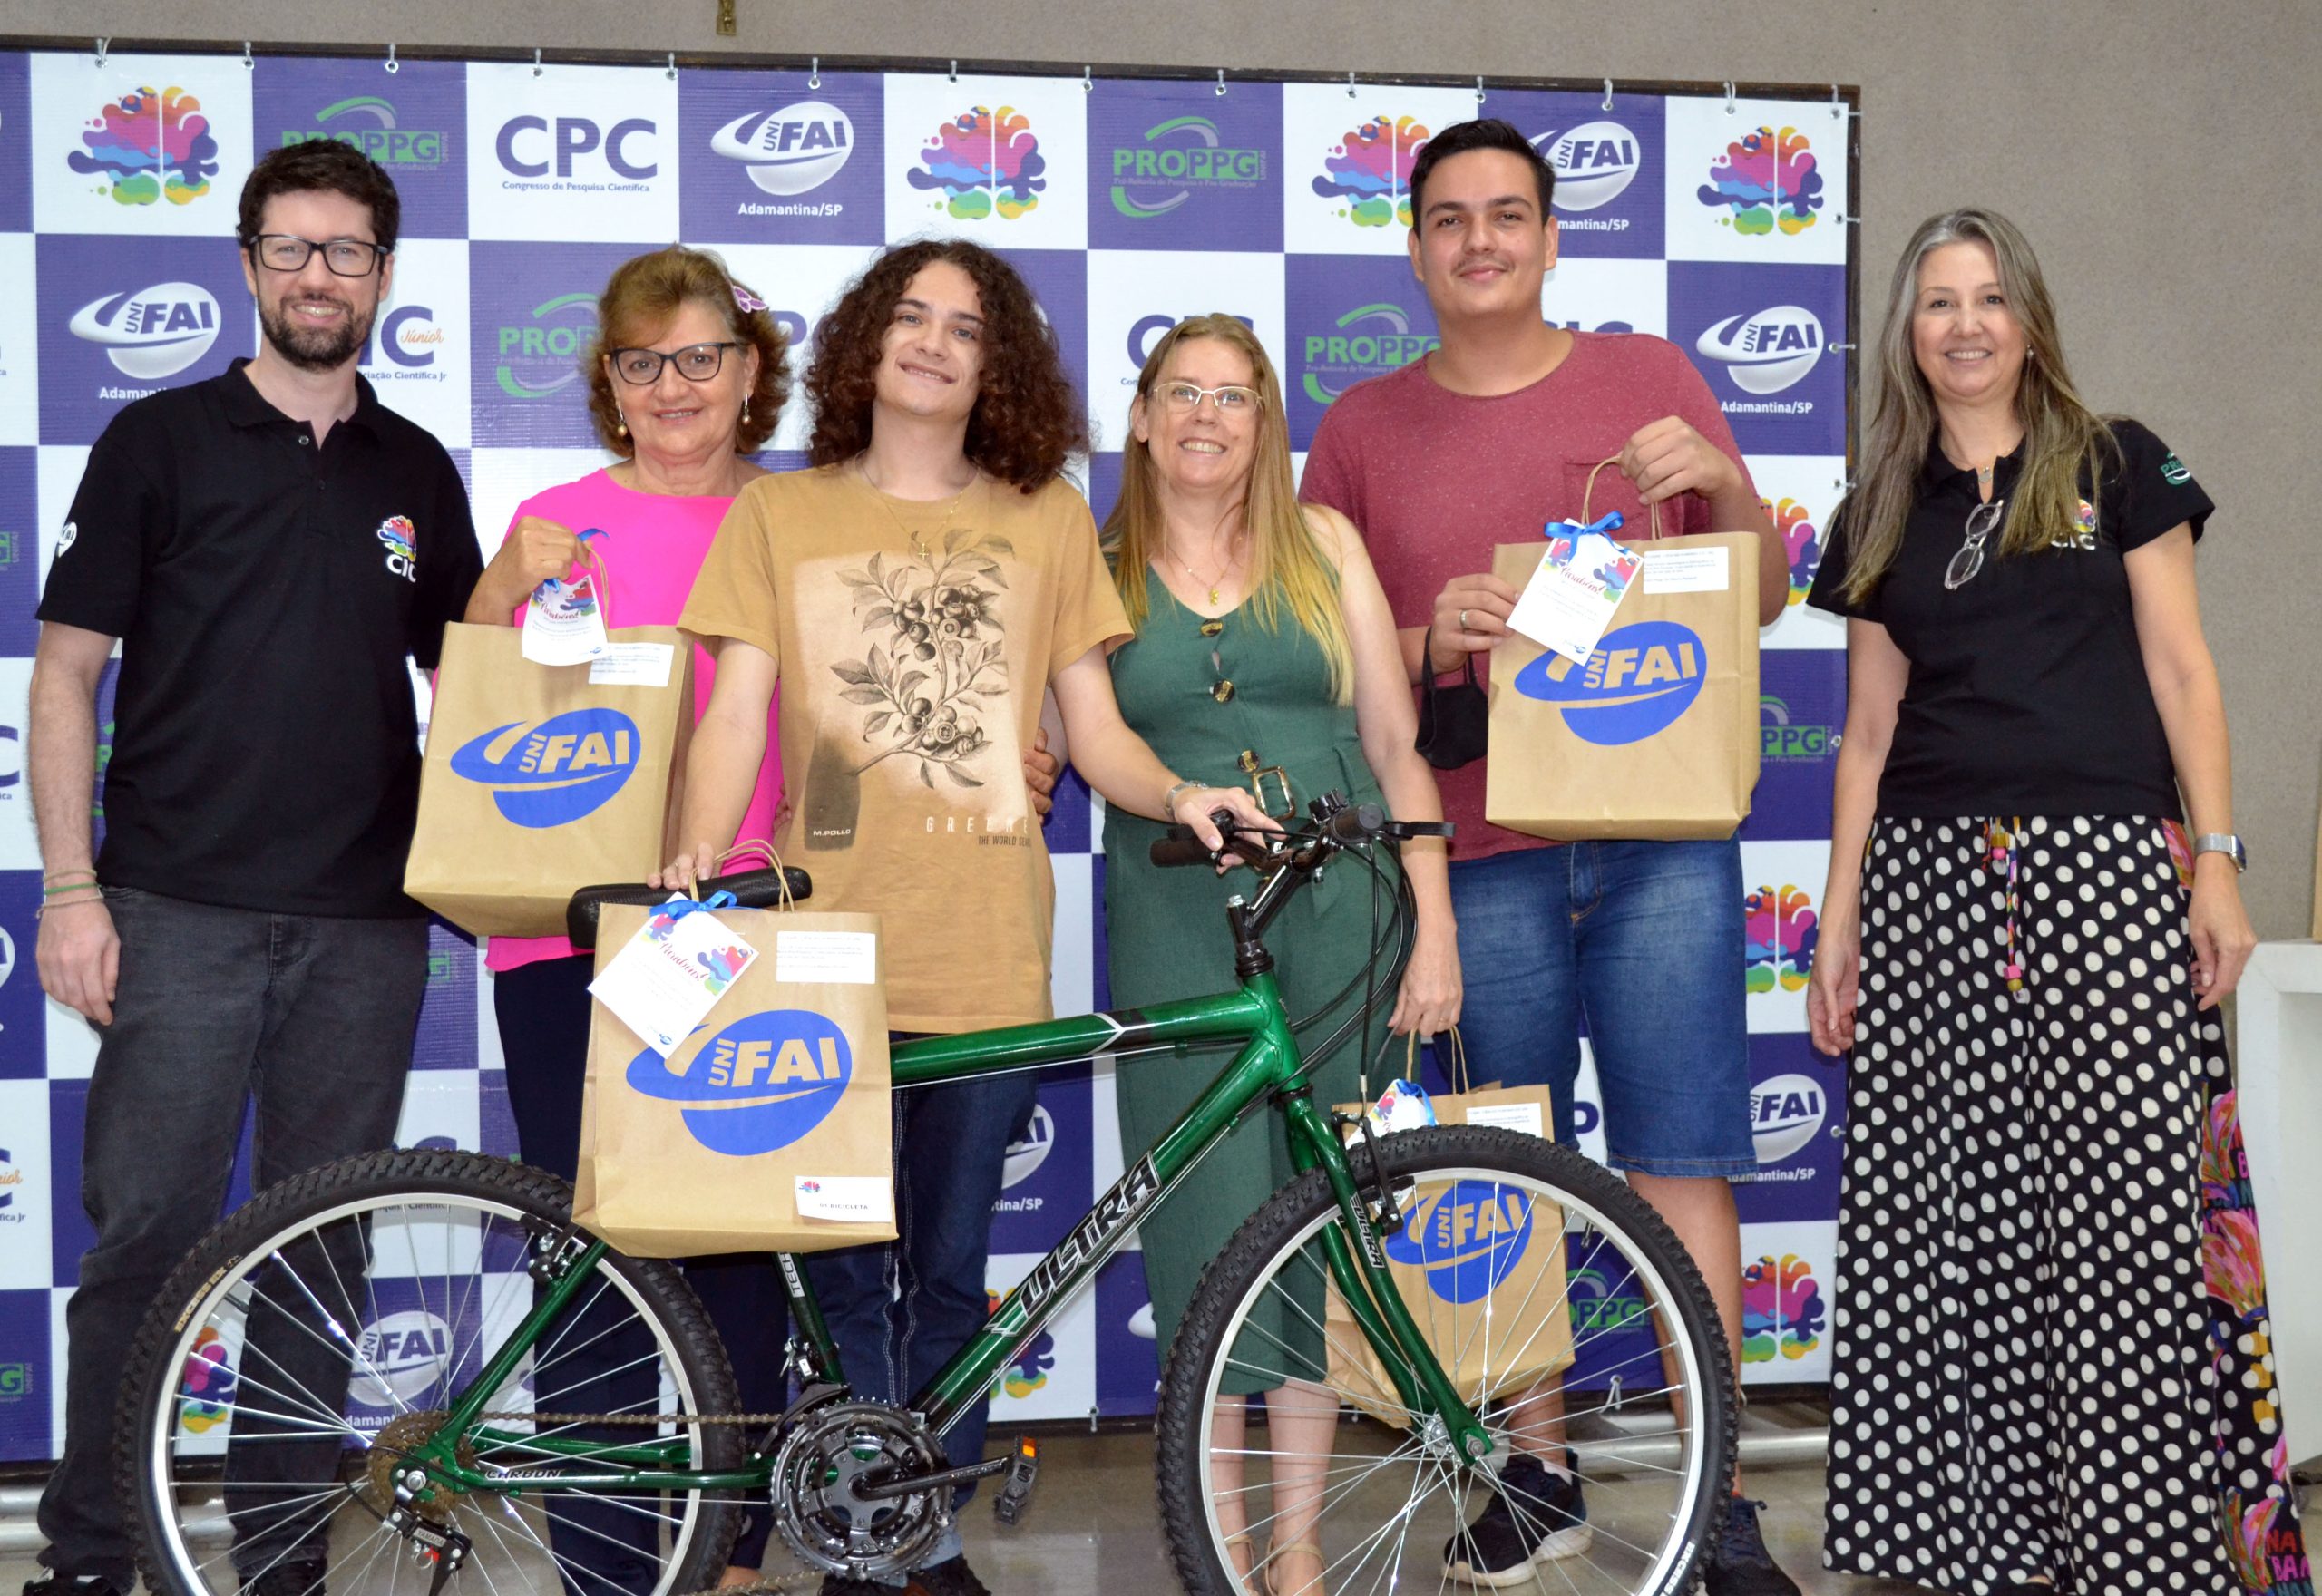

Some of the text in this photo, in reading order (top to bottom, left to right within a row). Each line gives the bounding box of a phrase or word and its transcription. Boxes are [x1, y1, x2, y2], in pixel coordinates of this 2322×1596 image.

[496, 115, 658, 180] CPC
[777, 121, 847, 152] FAI
[1113, 149, 1256, 178] PROPPG
[1570, 140, 1634, 170] FAI
[502, 180, 650, 192] Congresso de Pesquisa Científica
[737, 202, 843, 217] Adamantina/SP
[1557, 218, 1630, 231] mantina/SP
[140, 301, 214, 335] FAI
[1756, 323, 1818, 354] FAI
[395, 371, 437, 380] Científica
[440, 372, 447, 382] Jr
[1721, 401, 1814, 414] Adamantina/SP
[1603, 642, 1698, 689] FAI
[537, 729, 630, 774] FAI
[813, 828, 851, 836] M.POLLO
[992, 835, 1017, 846] WORLD
[731, 1036, 841, 1087] FAI
[1758, 1091, 1820, 1123] FAI
